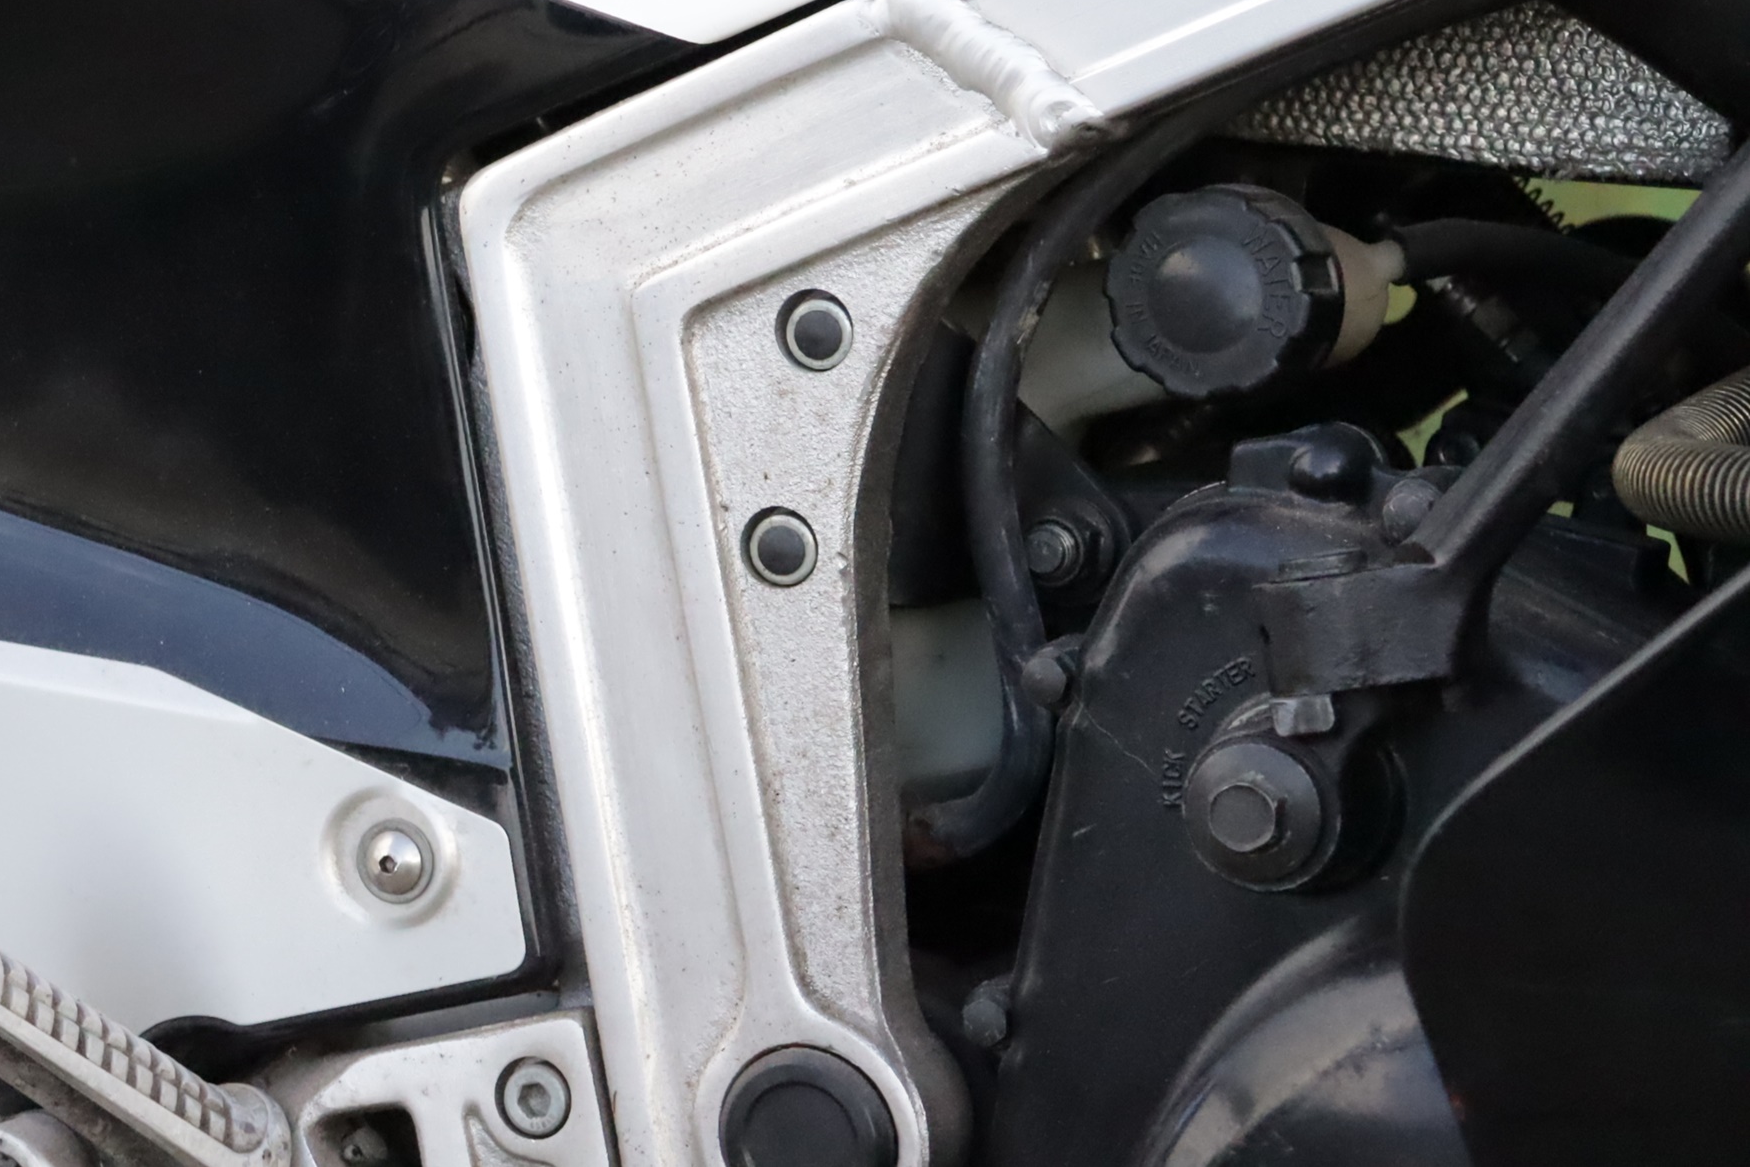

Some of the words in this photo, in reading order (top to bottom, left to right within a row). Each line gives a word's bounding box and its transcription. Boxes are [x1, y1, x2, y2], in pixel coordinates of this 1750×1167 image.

[1241, 221, 1292, 338] WATER
[1125, 301, 1148, 325] IN
[1145, 334, 1202, 376] JAPAN
[1159, 747, 1186, 808] KICK
[1177, 656, 1256, 730] STARTER
